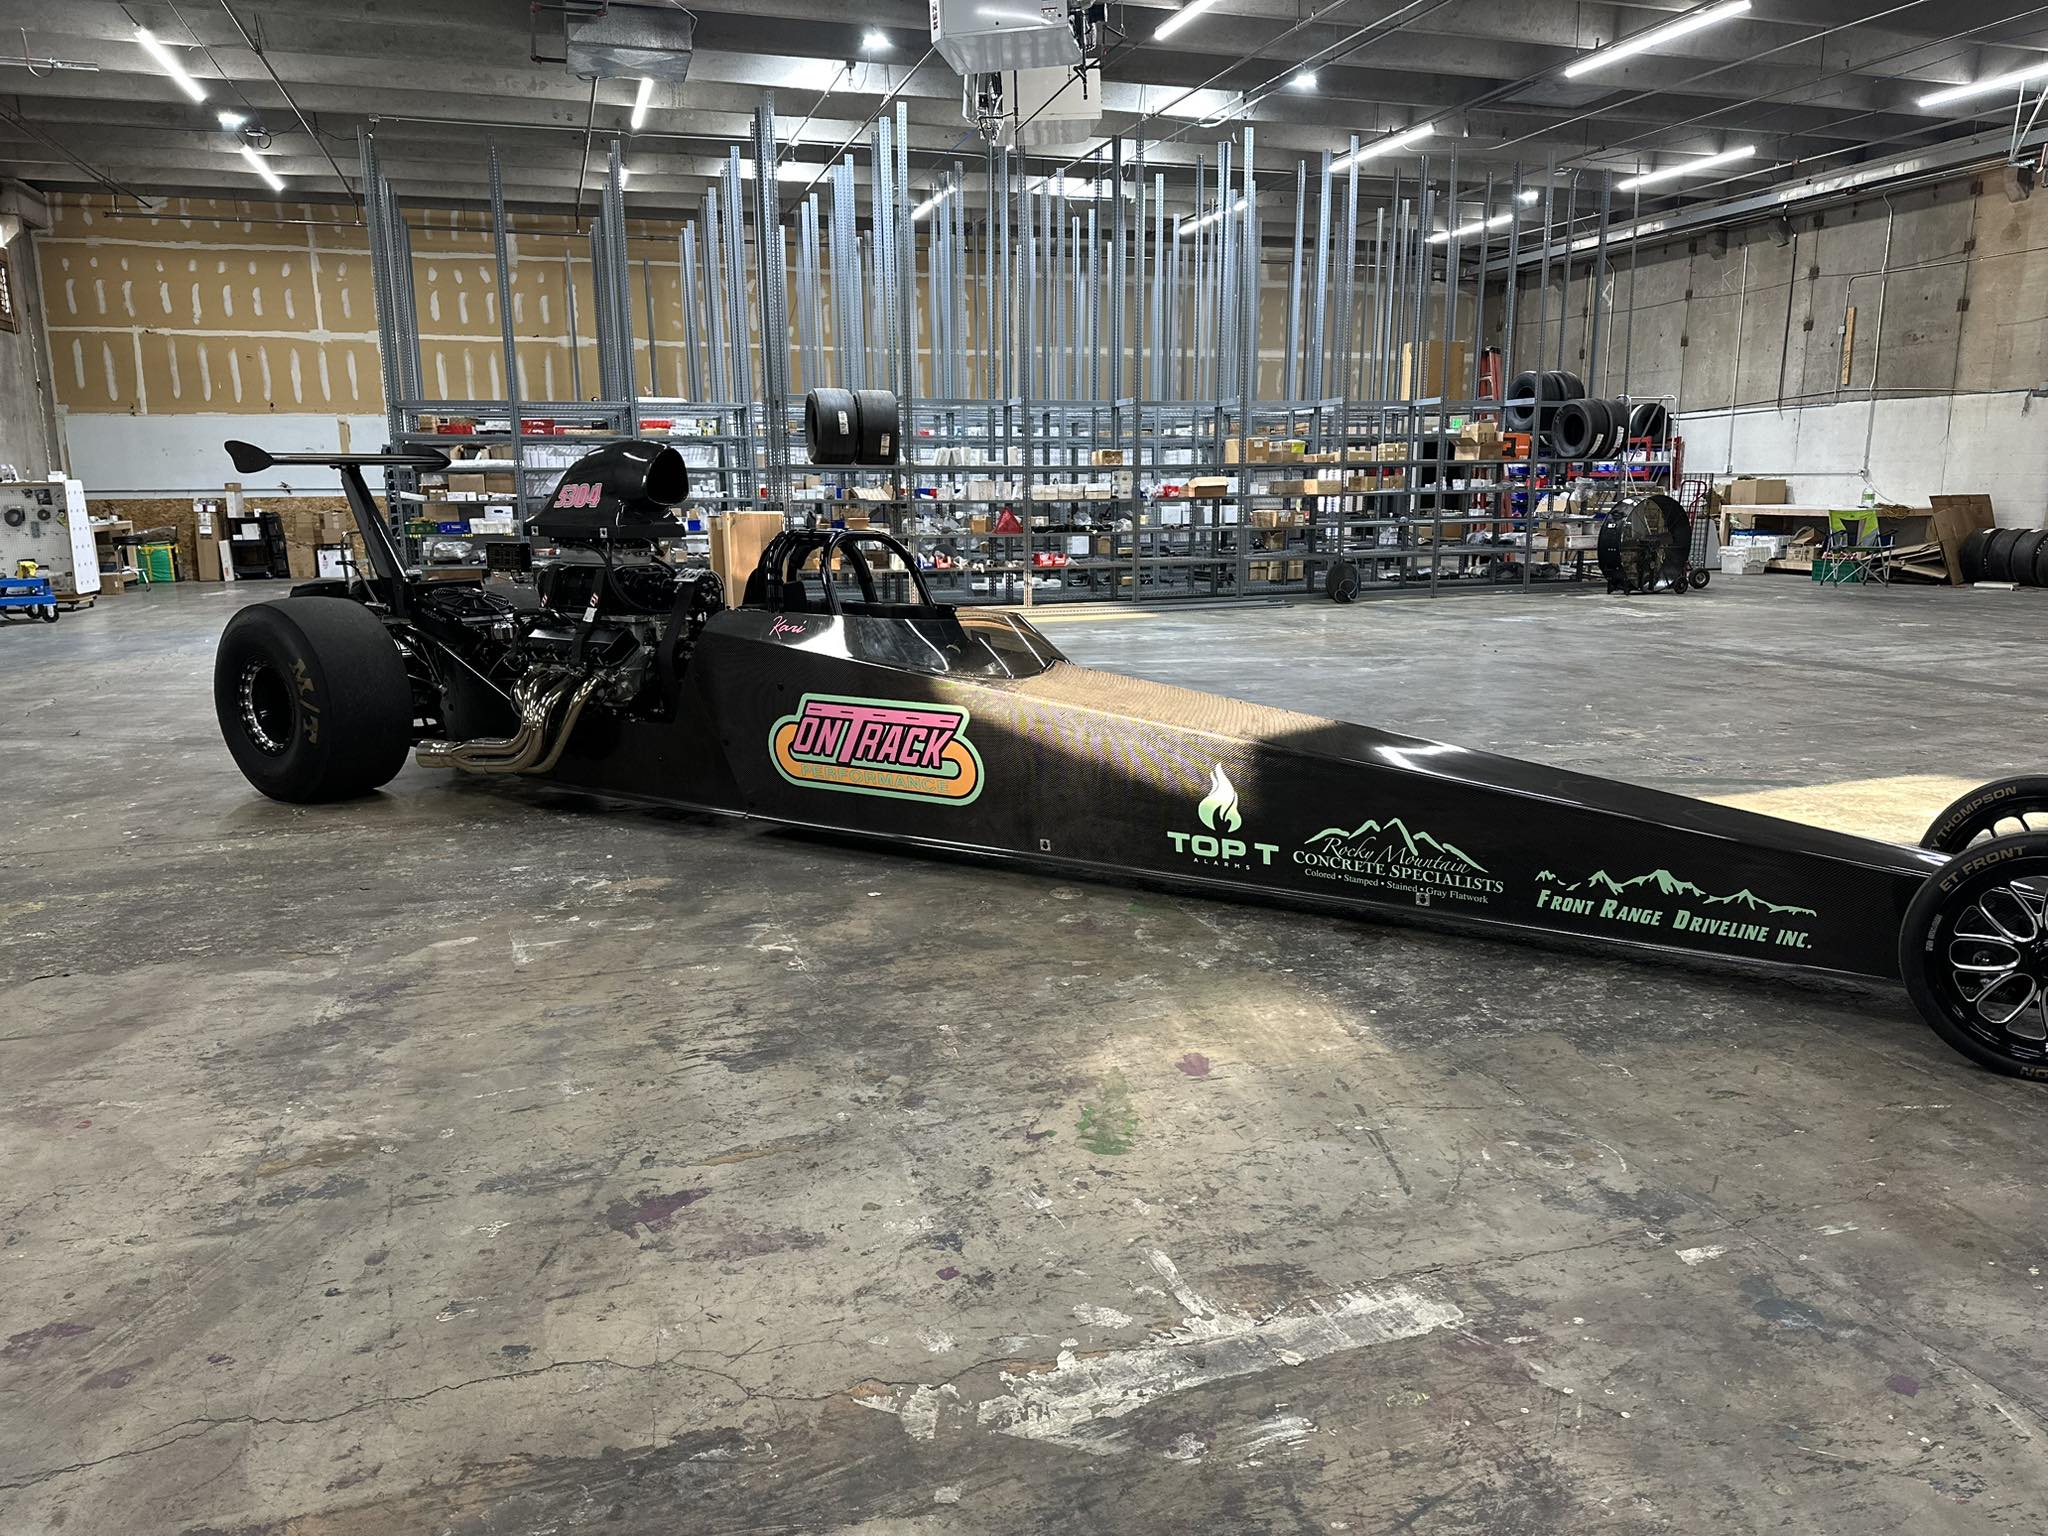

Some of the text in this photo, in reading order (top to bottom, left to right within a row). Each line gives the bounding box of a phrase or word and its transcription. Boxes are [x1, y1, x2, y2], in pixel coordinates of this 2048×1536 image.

[553, 483, 602, 509] 5304
[793, 702, 962, 767] ONTRACK
[800, 762, 950, 794] PERFORMANCE
[1937, 786, 2017, 840] THOMPSON
[1167, 831, 1280, 866] TOP T
[1193, 857, 1251, 870] ALARMS
[1321, 836, 1472, 874] Rocky Mountain
[1292, 850, 1505, 894] CONCRETE SPECIALISTS
[1304, 868, 1489, 904] Colored Stamped Stained Gray Flatwork
[1939, 871, 1959, 892] ET
[1962, 845, 2028, 876] FRONT
[1536, 889, 1813, 949] FRONT RANGE DRIVELINE INC.
